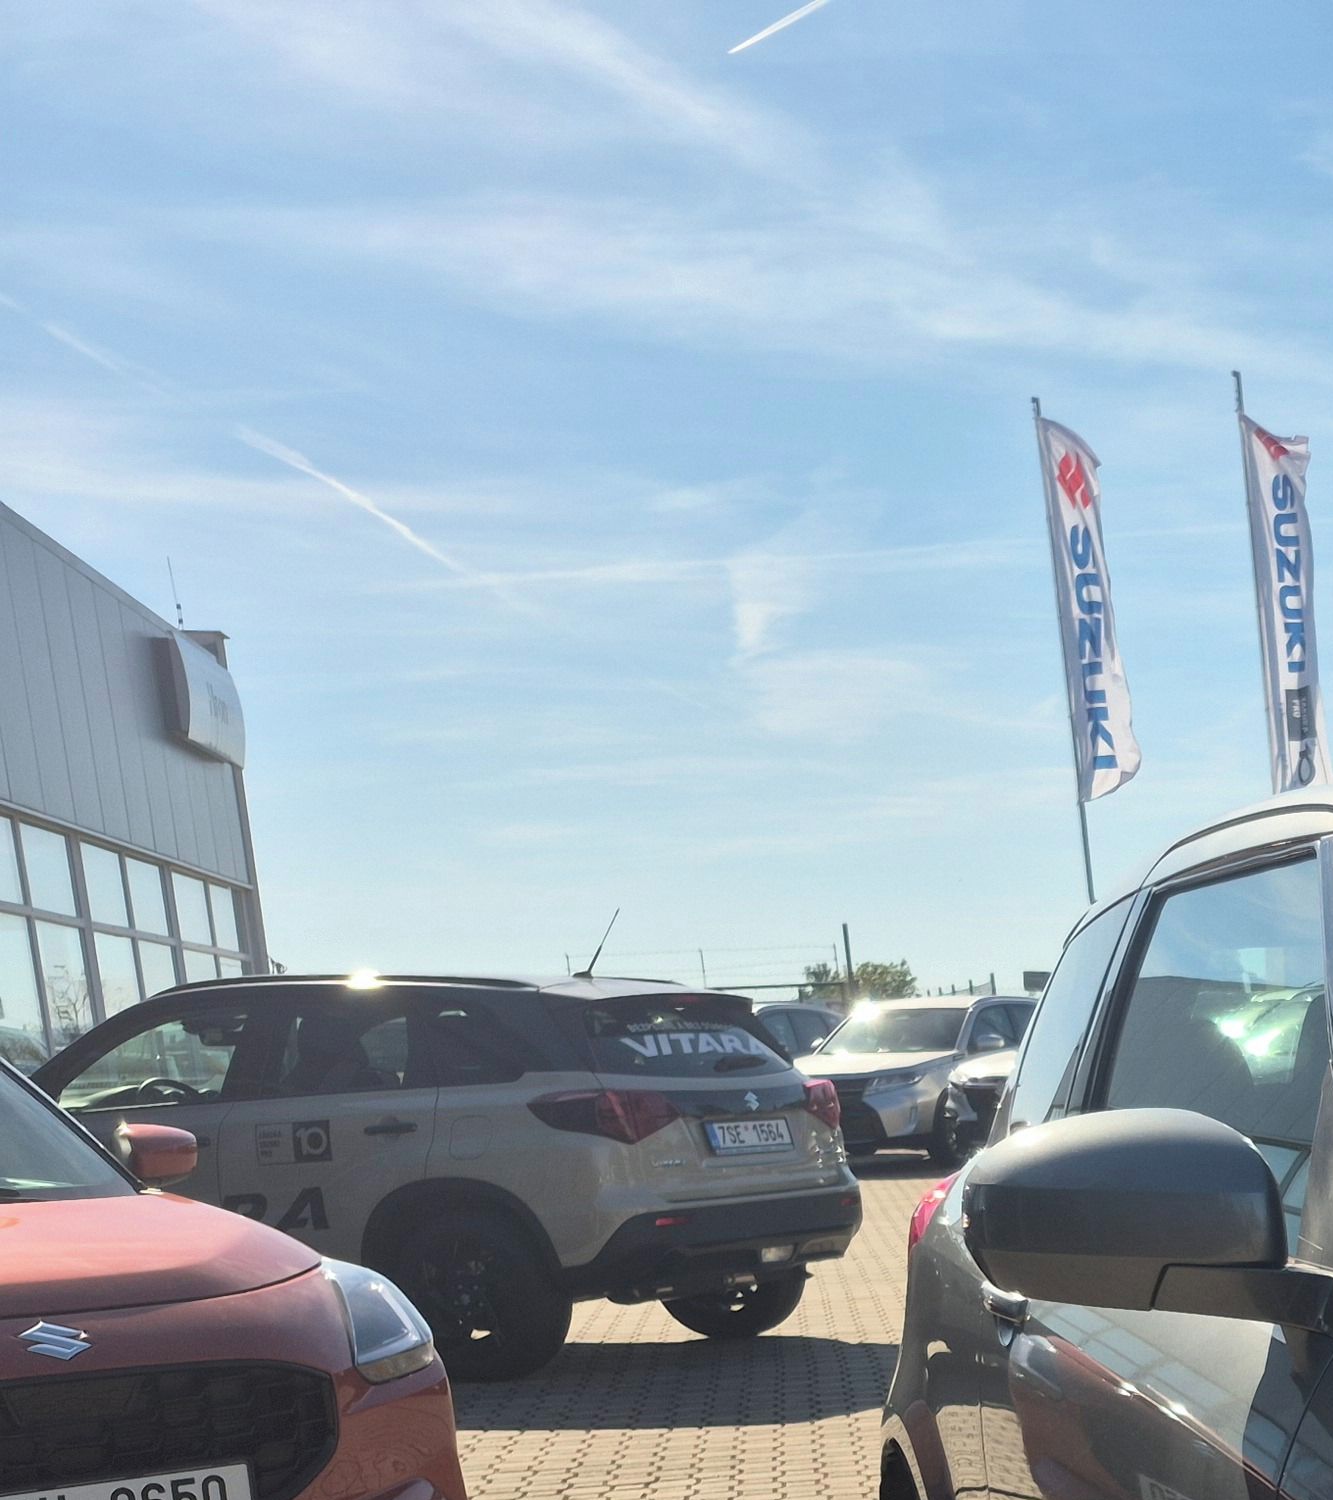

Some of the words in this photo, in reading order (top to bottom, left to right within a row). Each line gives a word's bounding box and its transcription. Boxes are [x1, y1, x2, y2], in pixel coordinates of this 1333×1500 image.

[1271, 473, 1306, 674] SUZUKI
[1069, 523, 1119, 771] SUZUKI
[620, 1031, 769, 1058] VITARA
[717, 1123, 746, 1145] 7SE
[752, 1121, 785, 1143] 1564
